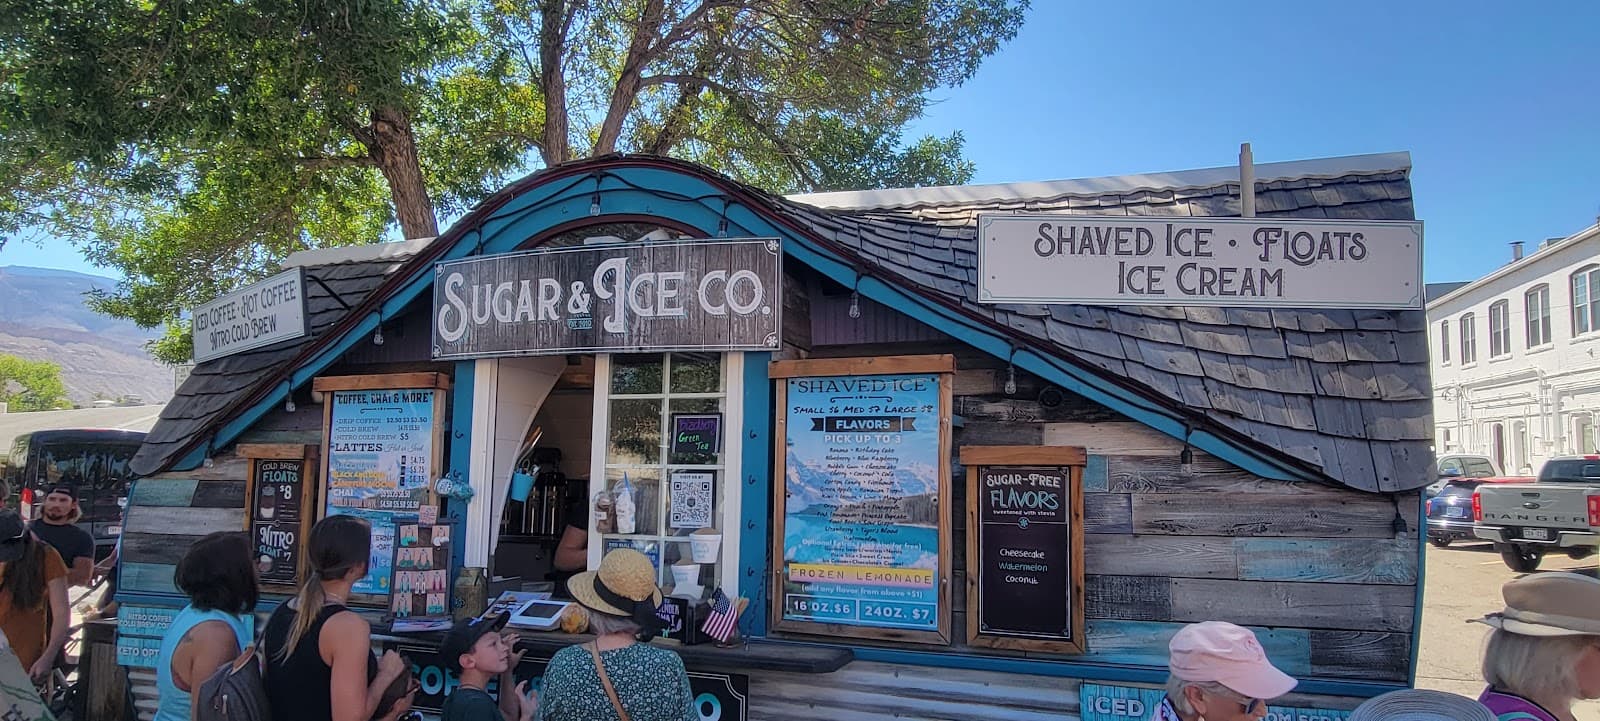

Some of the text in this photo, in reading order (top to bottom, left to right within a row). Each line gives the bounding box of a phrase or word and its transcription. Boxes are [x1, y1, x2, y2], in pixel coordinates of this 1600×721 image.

[1034, 222, 1367, 267] SHAVED ICE FLOATS
[1119, 261, 1283, 297] ICE CREAM
[437, 257, 772, 342] SUGAR & ICE CO.
[195, 280, 296, 334] ICED COFFEE HOT COFFEE
[210, 313, 276, 351] NITRO COLD BREW
[798, 377, 927, 394] SHAVED ICE
[337, 393, 369, 406] COFFEE,
[393, 393, 399, 403] &
[402, 392, 428, 404] MORE
[793, 405, 824, 414] SMALL
[843, 405, 864, 413] MED
[884, 405, 917, 413] LARGE
[835, 419, 890, 430] FLAVORS
[679, 431, 701, 443] Green
[825, 434, 902, 444] PICK UP TO 3
[335, 443, 382, 452] LATTES
[696, 441, 710, 450] Tea
[856, 445, 880, 456] Birthday
[825, 455, 851, 463] Blueberry
[871, 455, 899, 464] Raspberry
[262, 462, 299, 472] COLD BREW
[263, 470, 298, 483] FLOATS
[830, 469, 847, 479] Cherry
[987, 473, 1061, 489] SUGAR-FREE
[280, 485, 292, 500] $8
[332, 488, 355, 498] CHAI
[884, 494, 904, 505] Mango
[990, 489, 1059, 511] FLAVORS
[1484, 513, 1586, 524] RANGER
[825, 526, 856, 534] Strawberry
[259, 525, 295, 550] NITRO
[801, 539, 832, 548] Optional
[998, 548, 1045, 560] Cheesecake
[997, 561, 1048, 573] Watermelon
[790, 567, 933, 585] FROZEN LEMONADE
[1004, 574, 1039, 585] Coconut
[801, 583, 818, 592] (add
[819, 585, 834, 594] any
[836, 584, 859, 593] flavor
[860, 586, 879, 594] from
[880, 587, 905, 595] above
[793, 600, 807, 611] 16
[912, 607, 929, 620] $7
[1087, 695, 1145, 717] ICED
